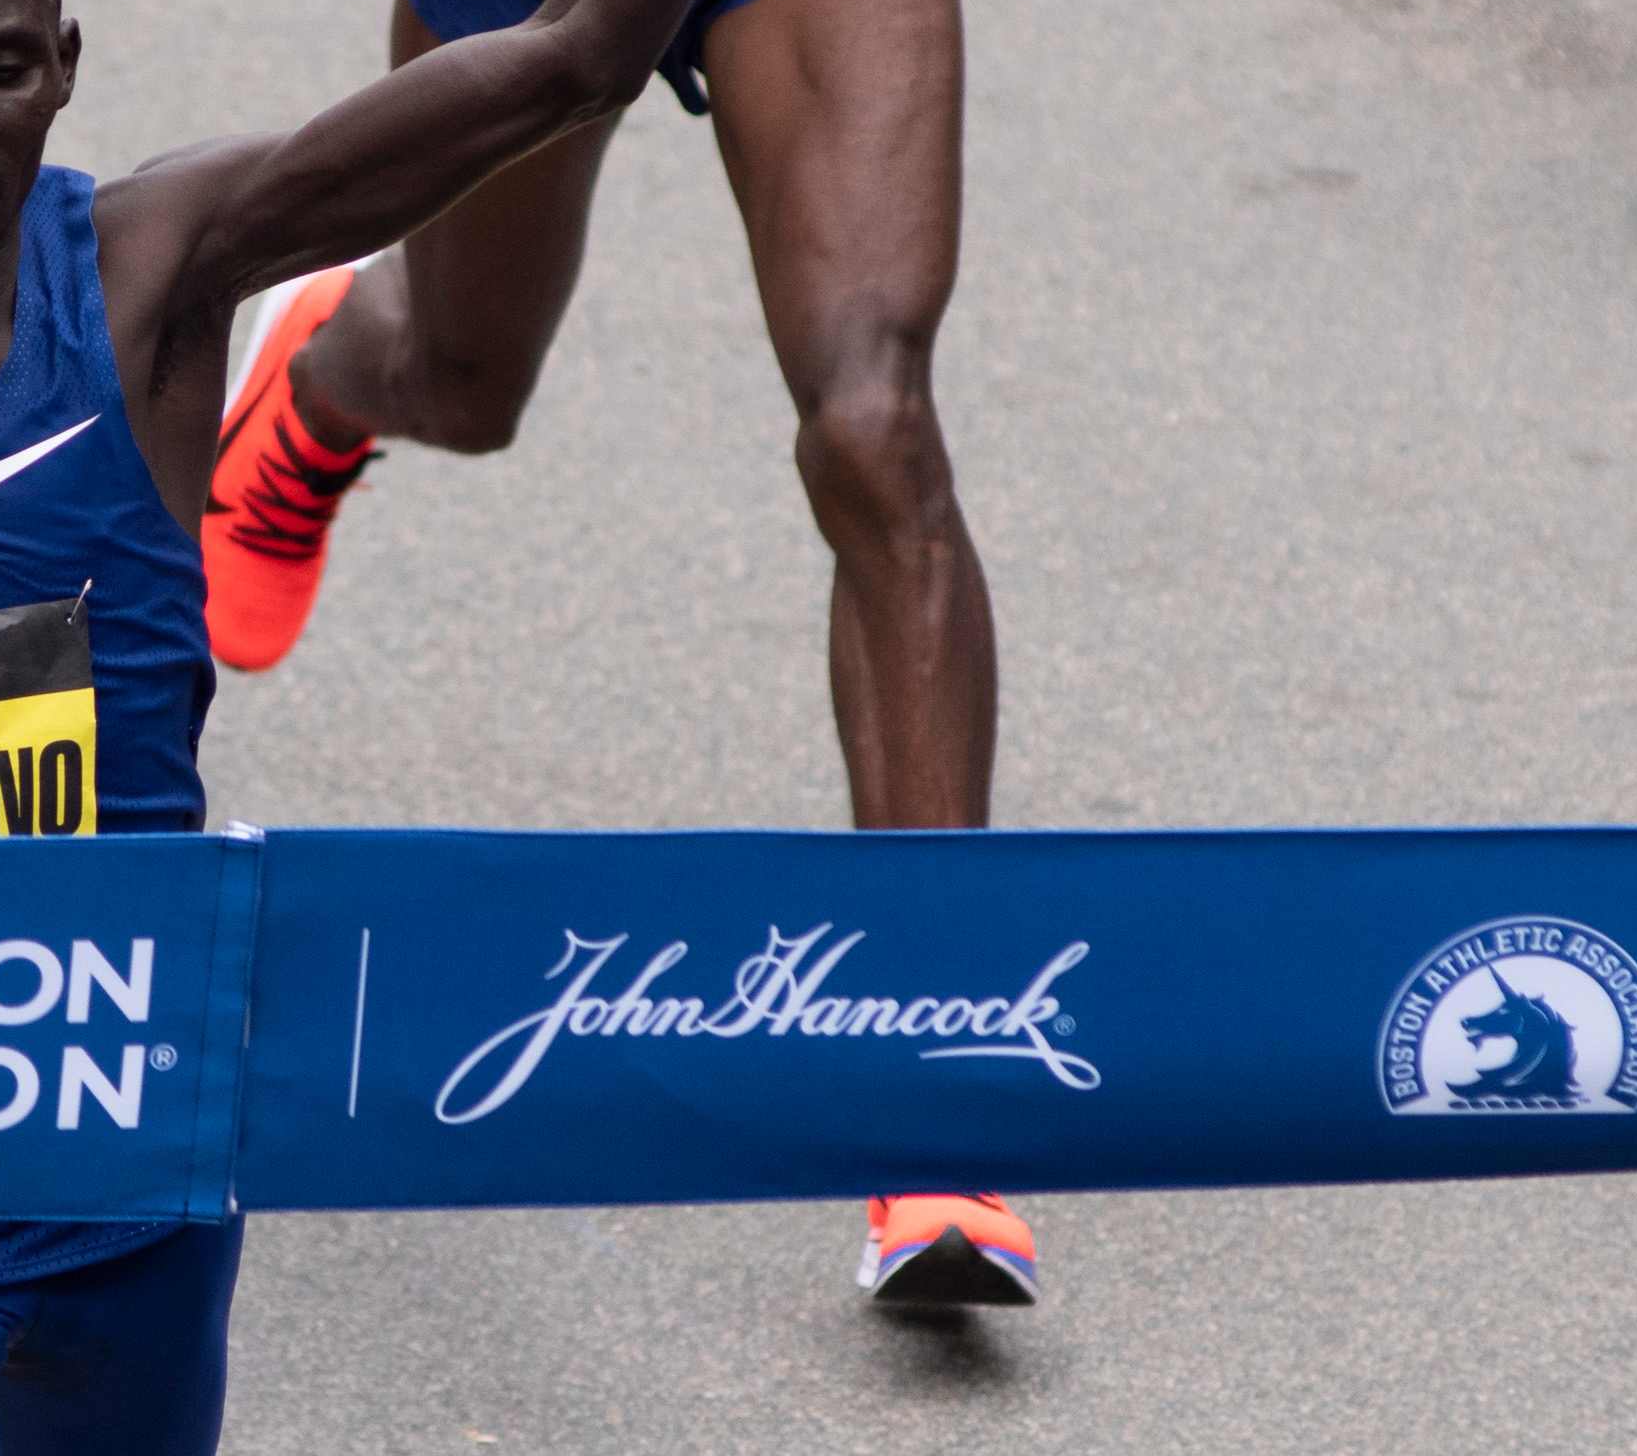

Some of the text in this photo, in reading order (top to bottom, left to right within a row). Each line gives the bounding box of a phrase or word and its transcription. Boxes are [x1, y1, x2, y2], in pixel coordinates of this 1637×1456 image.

[434, 920, 1102, 1126] John Hancock
[1392, 991, 1434, 1101] BOSTON
[1423, 925, 1564, 994] ATHLETIC
